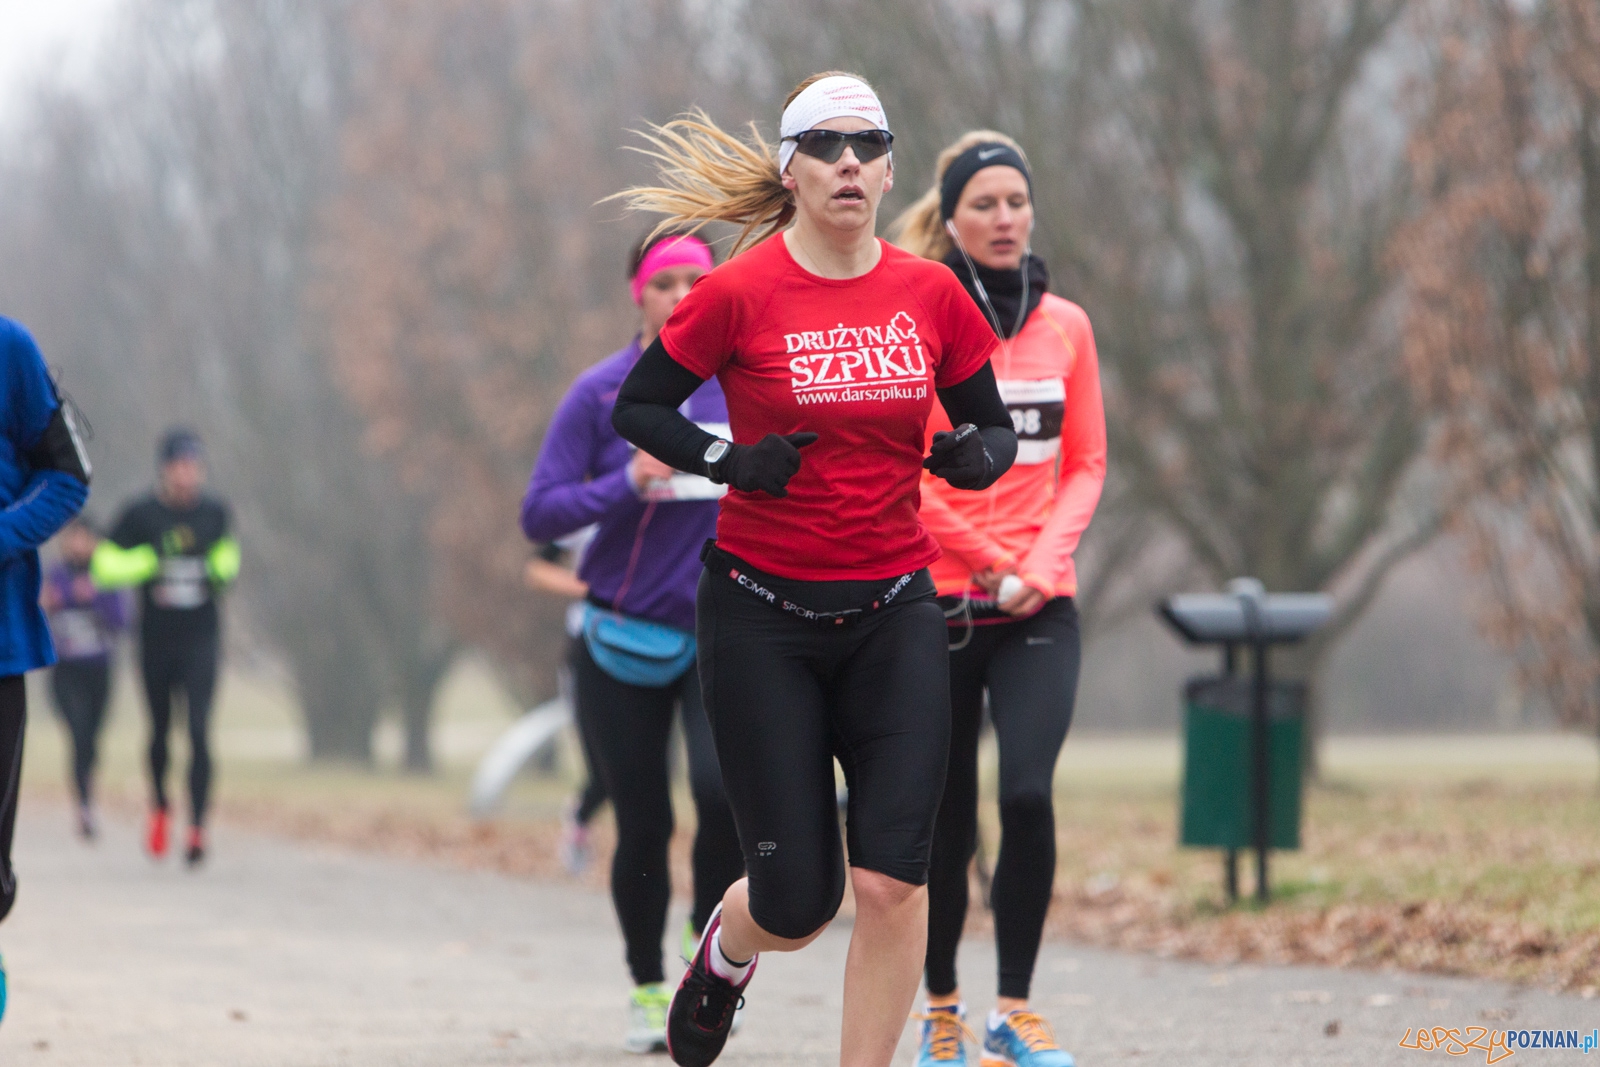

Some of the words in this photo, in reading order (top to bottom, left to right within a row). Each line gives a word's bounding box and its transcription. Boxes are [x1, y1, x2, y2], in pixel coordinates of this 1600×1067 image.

[783, 322, 901, 353] DRUŻYNA
[789, 345, 927, 388] SZPIKU
[796, 384, 927, 405] www.darszpiku.pl
